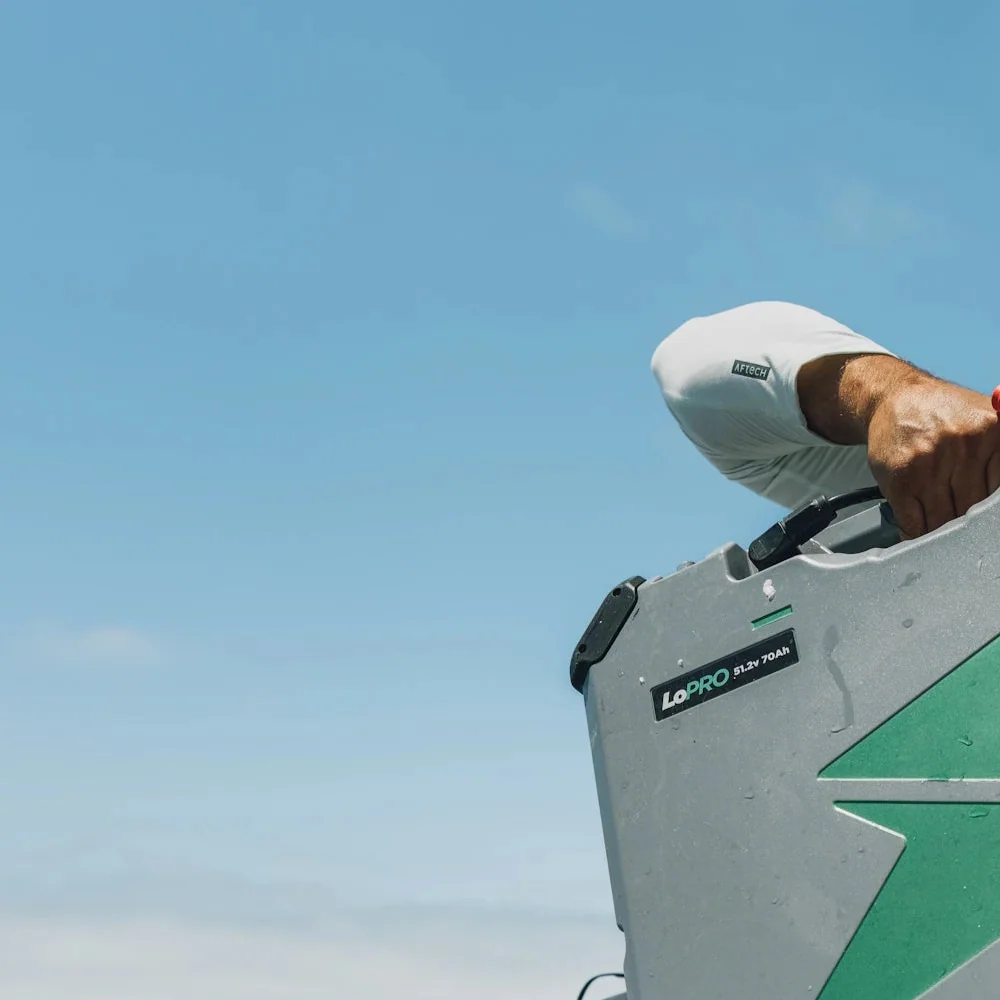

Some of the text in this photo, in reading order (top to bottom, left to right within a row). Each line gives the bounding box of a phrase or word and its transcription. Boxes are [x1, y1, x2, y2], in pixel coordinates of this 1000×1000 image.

[662, 646, 790, 711] LoPRO 51.2v 70Ah
